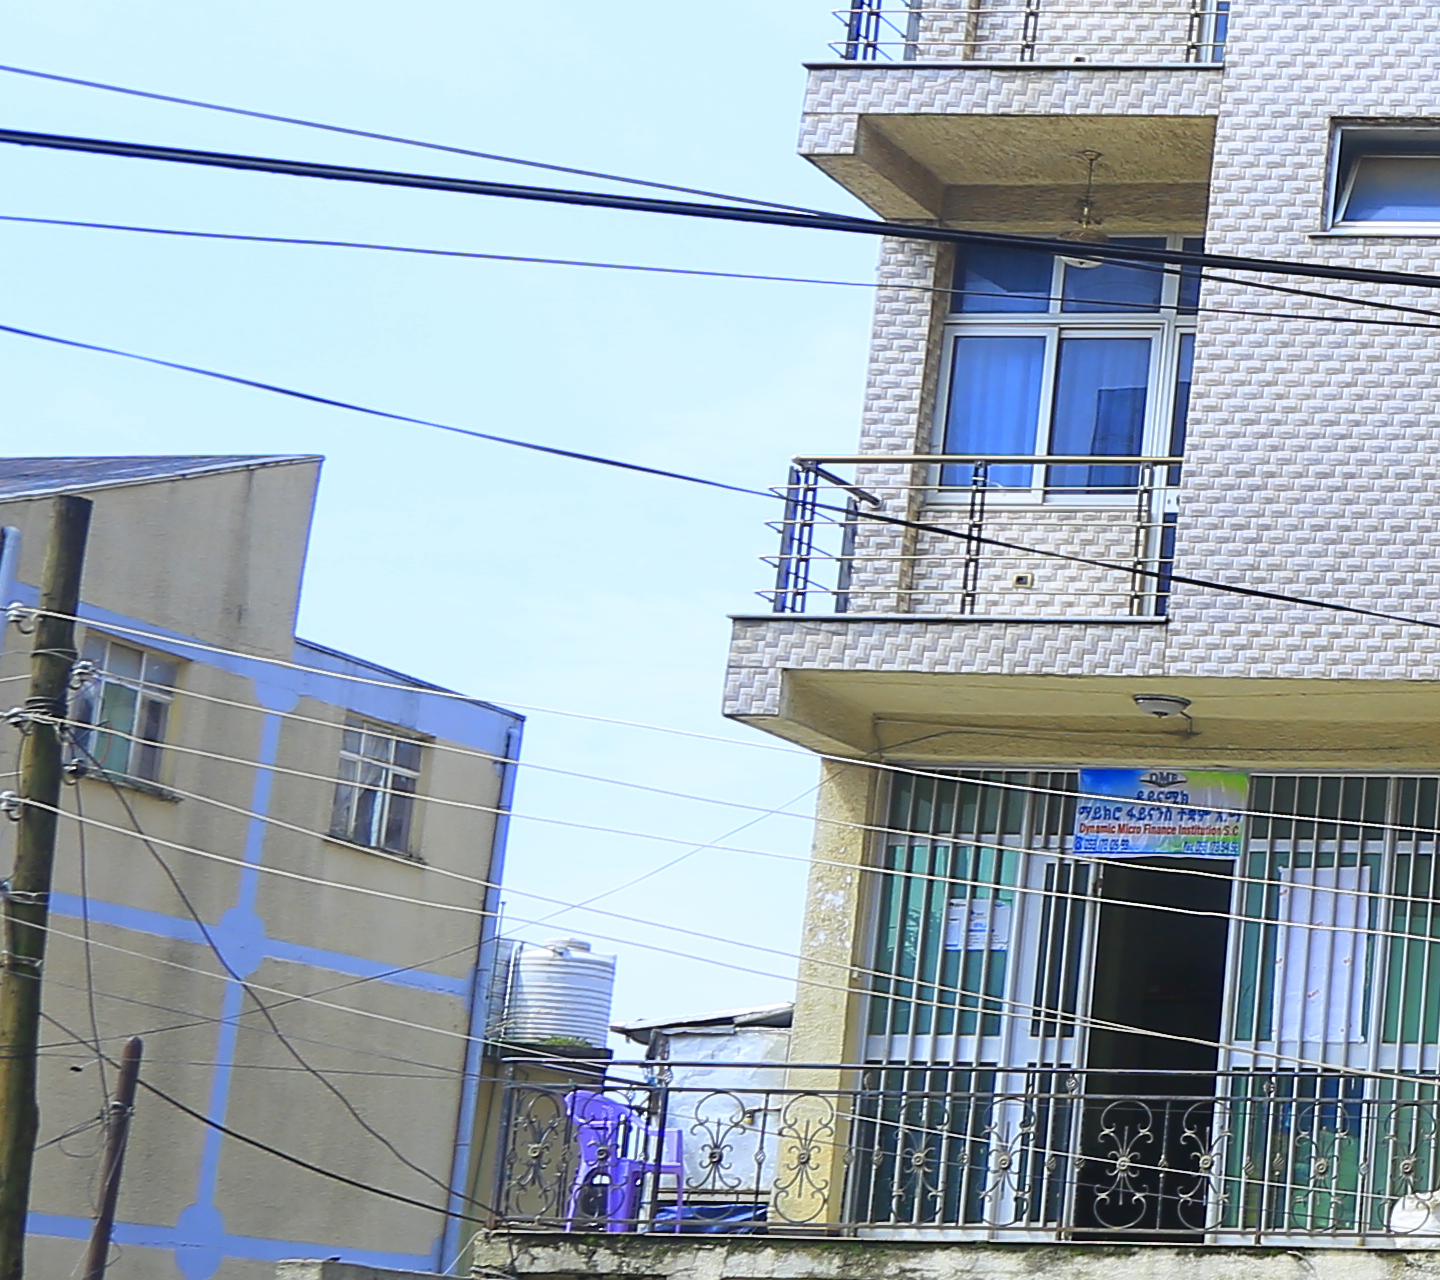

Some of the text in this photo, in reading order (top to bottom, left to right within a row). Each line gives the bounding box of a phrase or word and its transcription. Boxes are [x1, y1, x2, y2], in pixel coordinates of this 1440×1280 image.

[1079, 822, 1116, 836] Dynamic
[1117, 823, 1142, 835] Micro
[1143, 824, 1177, 836] Finance
[1179, 825, 1222, 837] Institution
